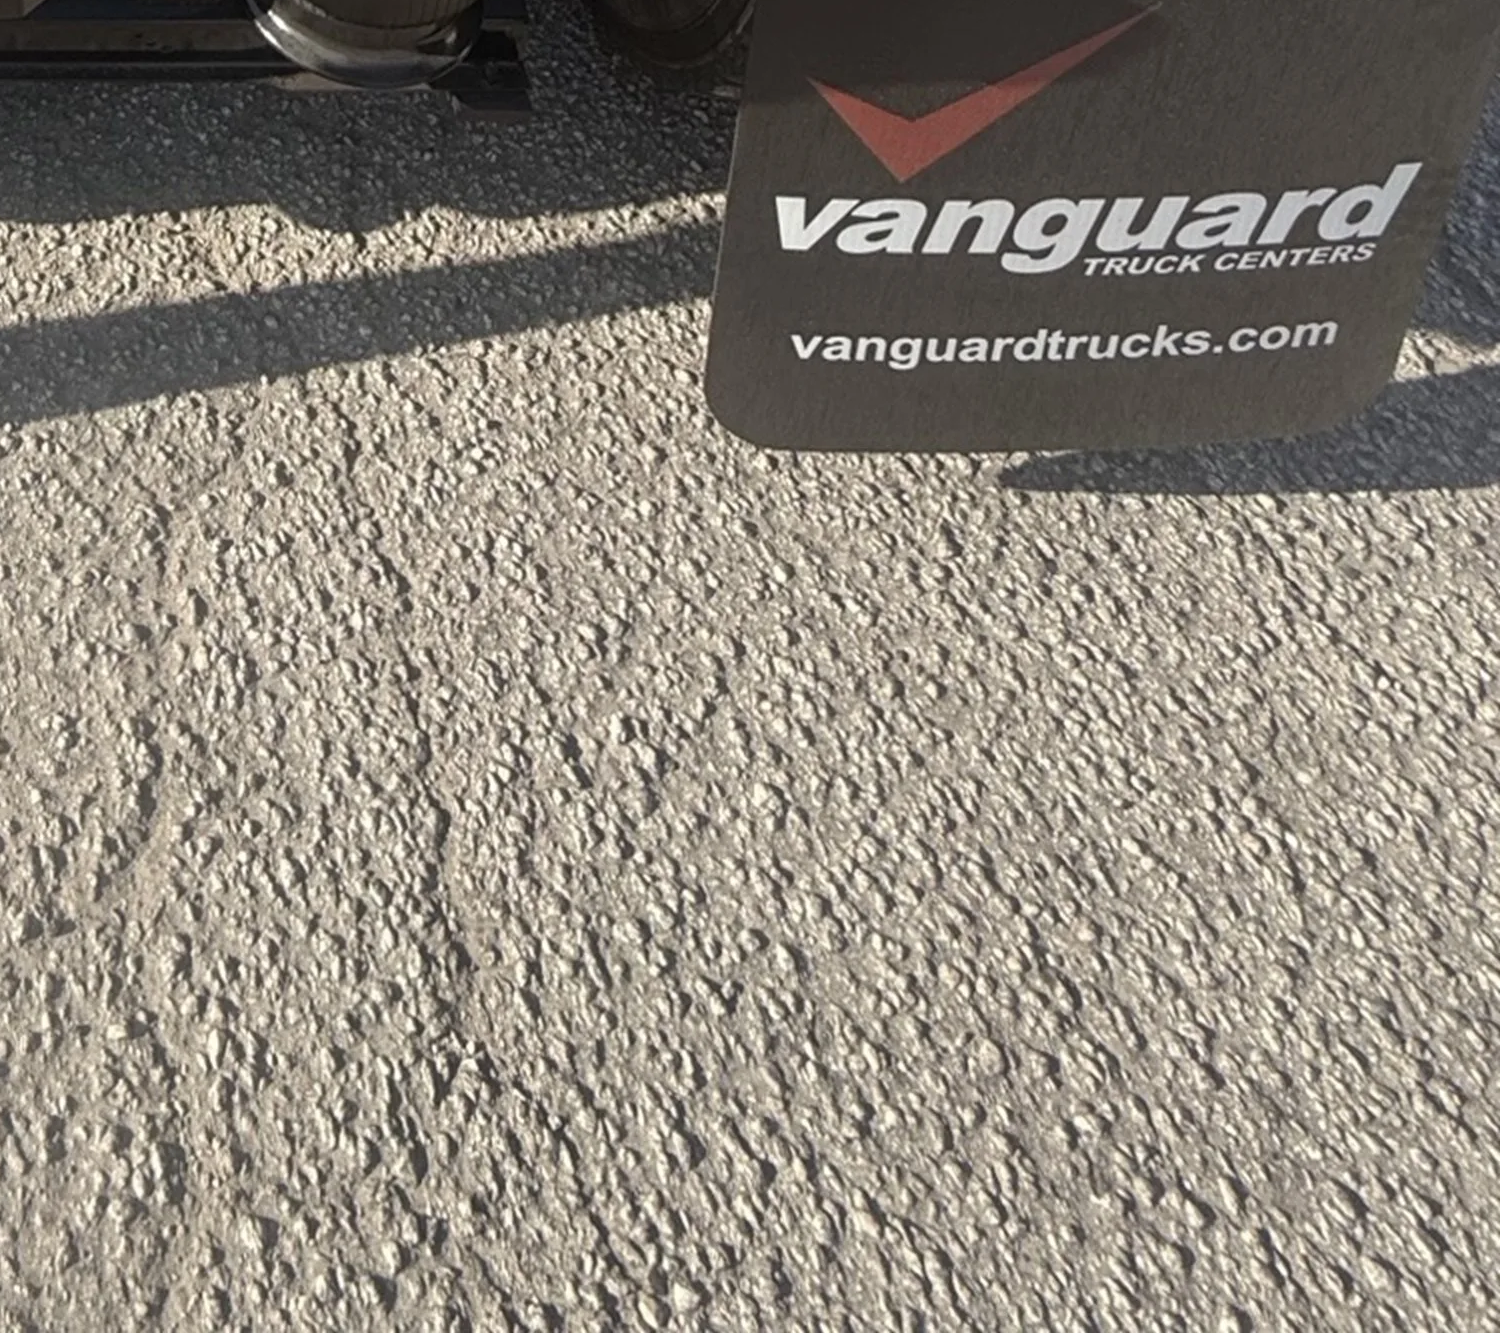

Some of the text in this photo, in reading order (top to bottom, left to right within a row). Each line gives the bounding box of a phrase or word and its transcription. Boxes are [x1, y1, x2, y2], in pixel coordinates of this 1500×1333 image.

[775, 163, 1422, 274] vanguard
[1084, 243, 1377, 276] TRUCK CENTERS
[791, 321, 1338, 371] vanguardtrucks.com
